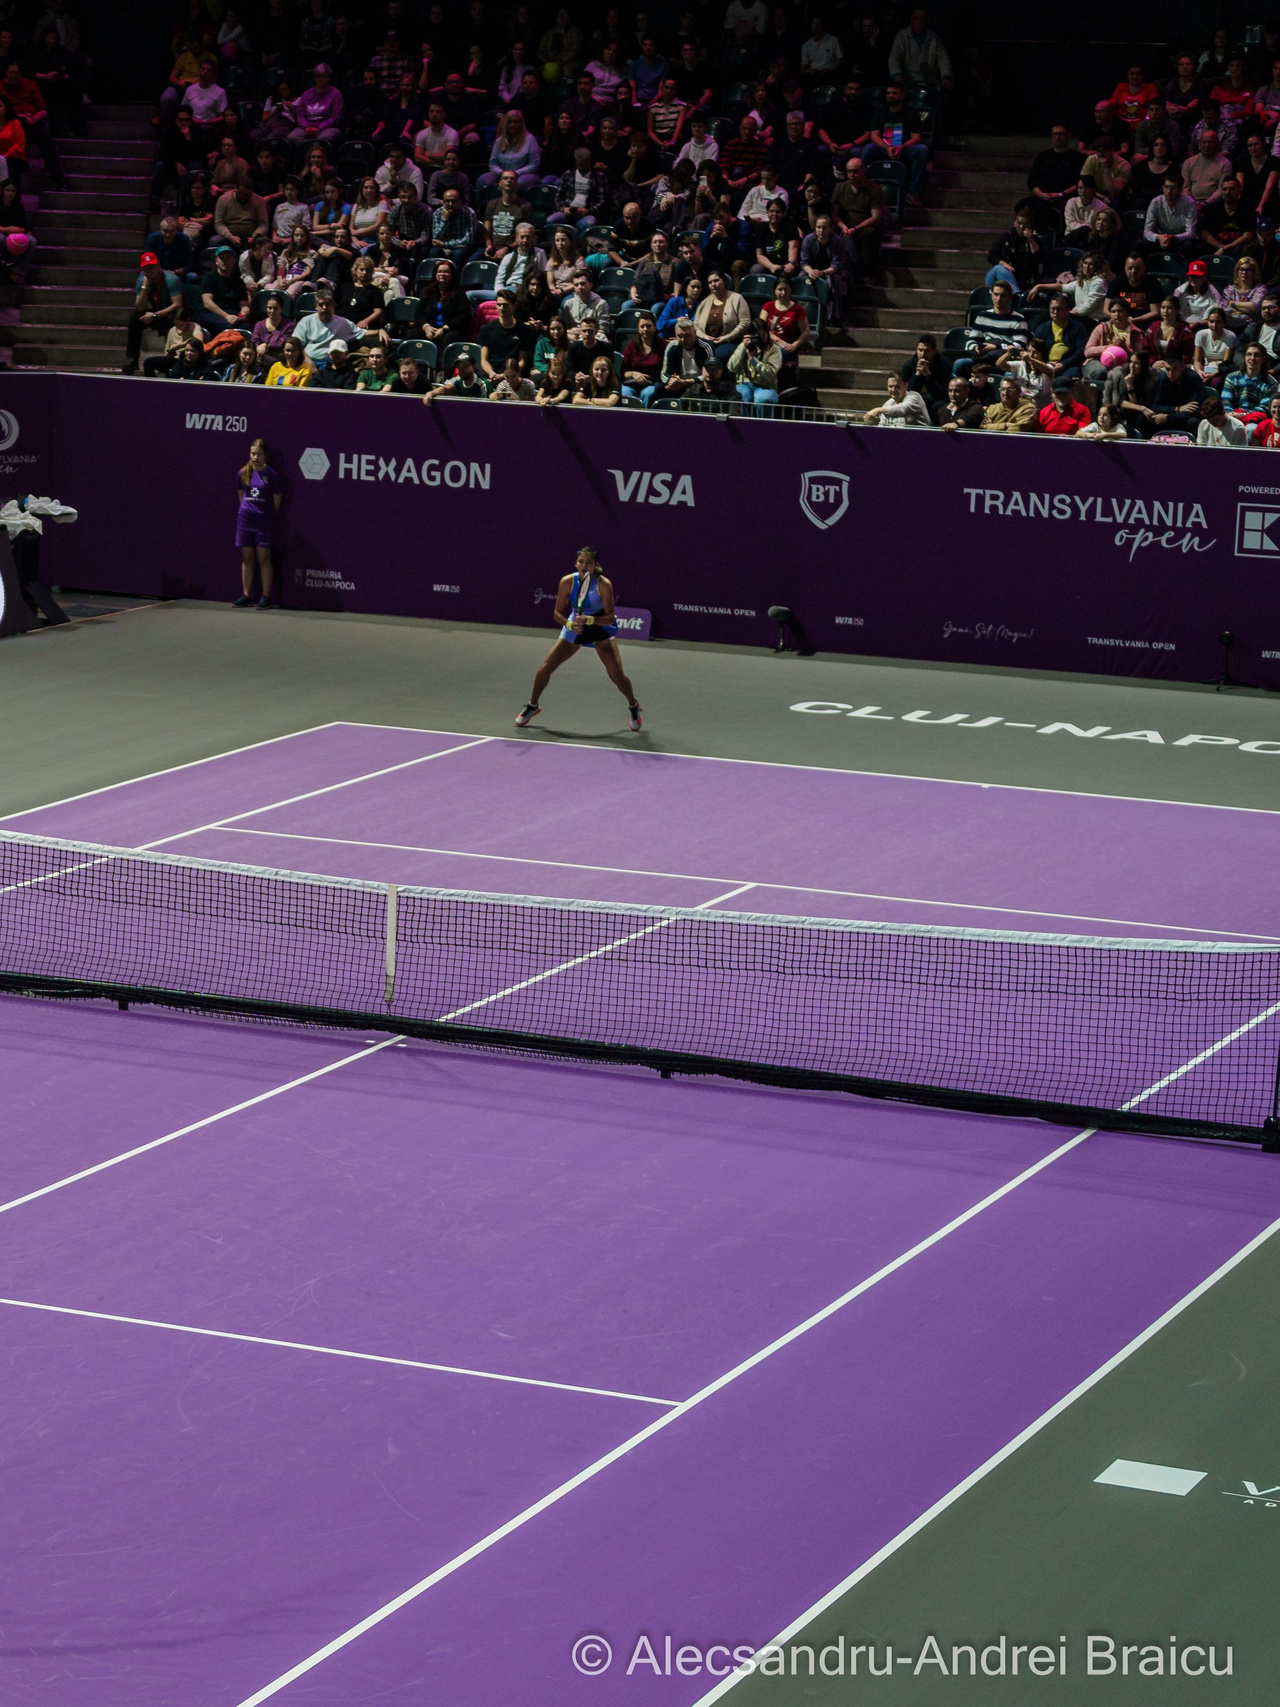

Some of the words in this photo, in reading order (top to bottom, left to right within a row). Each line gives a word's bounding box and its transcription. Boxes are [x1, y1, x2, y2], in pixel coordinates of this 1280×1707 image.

[186, 413, 223, 431] WTA
[225, 415, 248, 432] 250
[338, 453, 491, 490] HEXAGON
[607, 469, 696, 507] VISA
[810, 484, 840, 504] BT
[1238, 485, 1280, 495] POWERED
[963, 488, 1209, 529] TRANSYLVANIA
[1114, 526, 1217, 563] open
[433, 584, 450, 592] WTA
[673, 603, 732, 615] TRANSYLVANIA
[733, 608, 756, 617] OPEN
[835, 616, 853, 625] WTA
[1087, 637, 1150, 648] TRANSYLVANIA
[1152, 642, 1176, 650] OPEN
